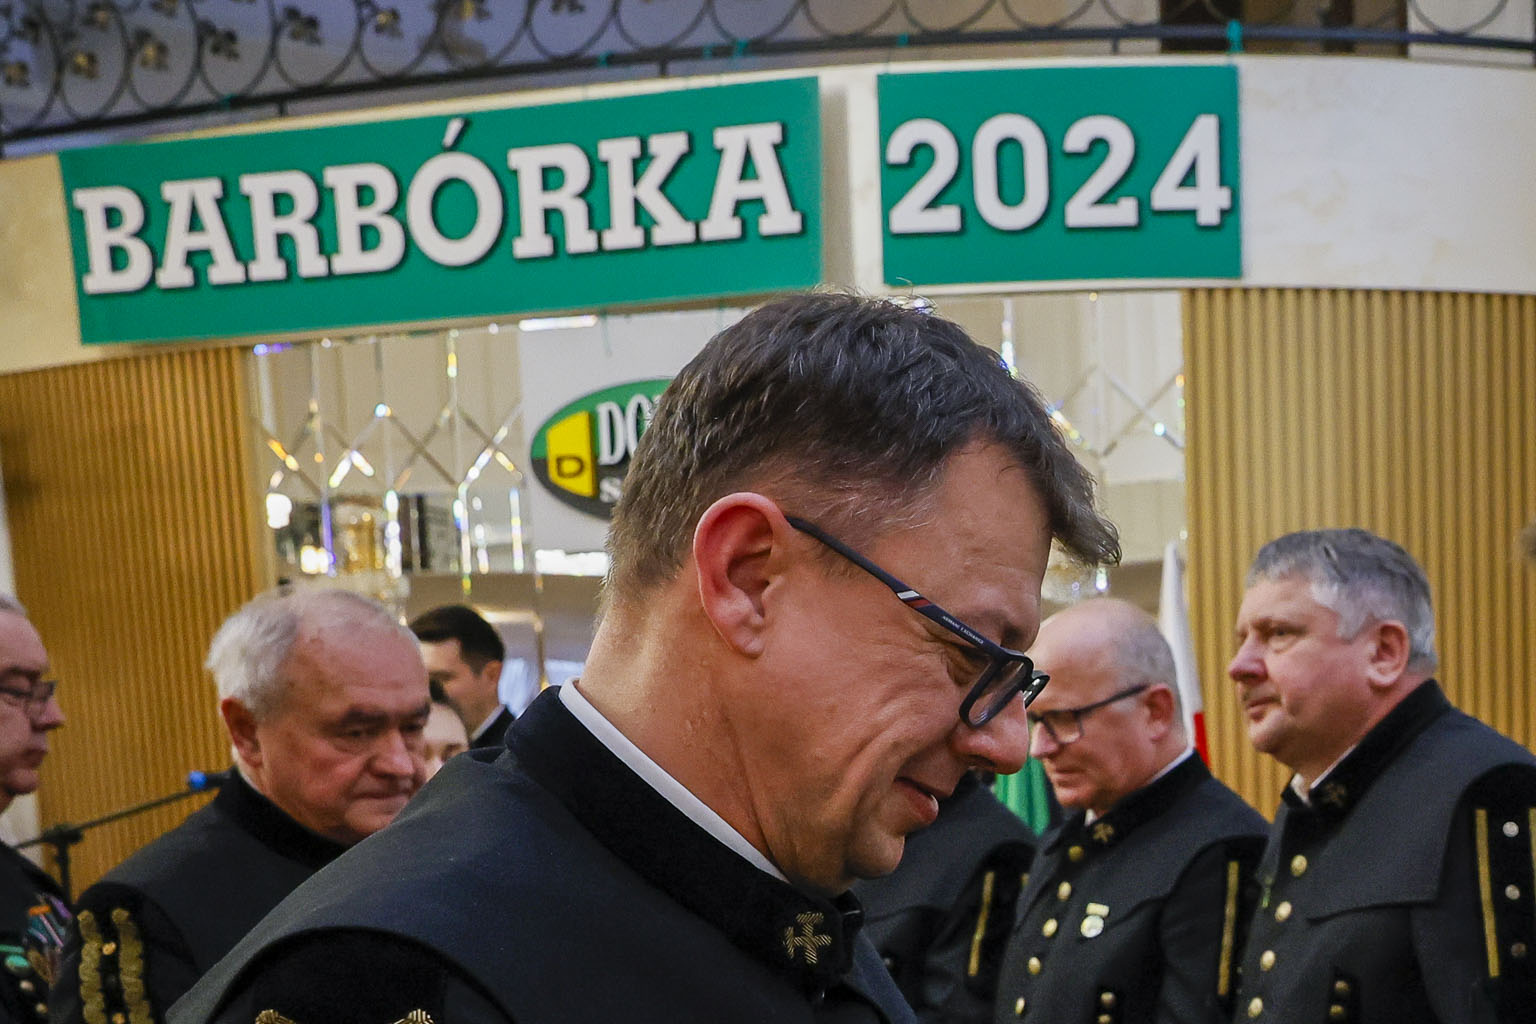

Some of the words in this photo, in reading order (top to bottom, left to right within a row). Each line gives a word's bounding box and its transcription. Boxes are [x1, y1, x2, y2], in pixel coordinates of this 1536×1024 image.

[71, 118, 803, 297] BARBÓRKA
[885, 111, 1233, 236] 2024
[596, 393, 664, 465] DO
